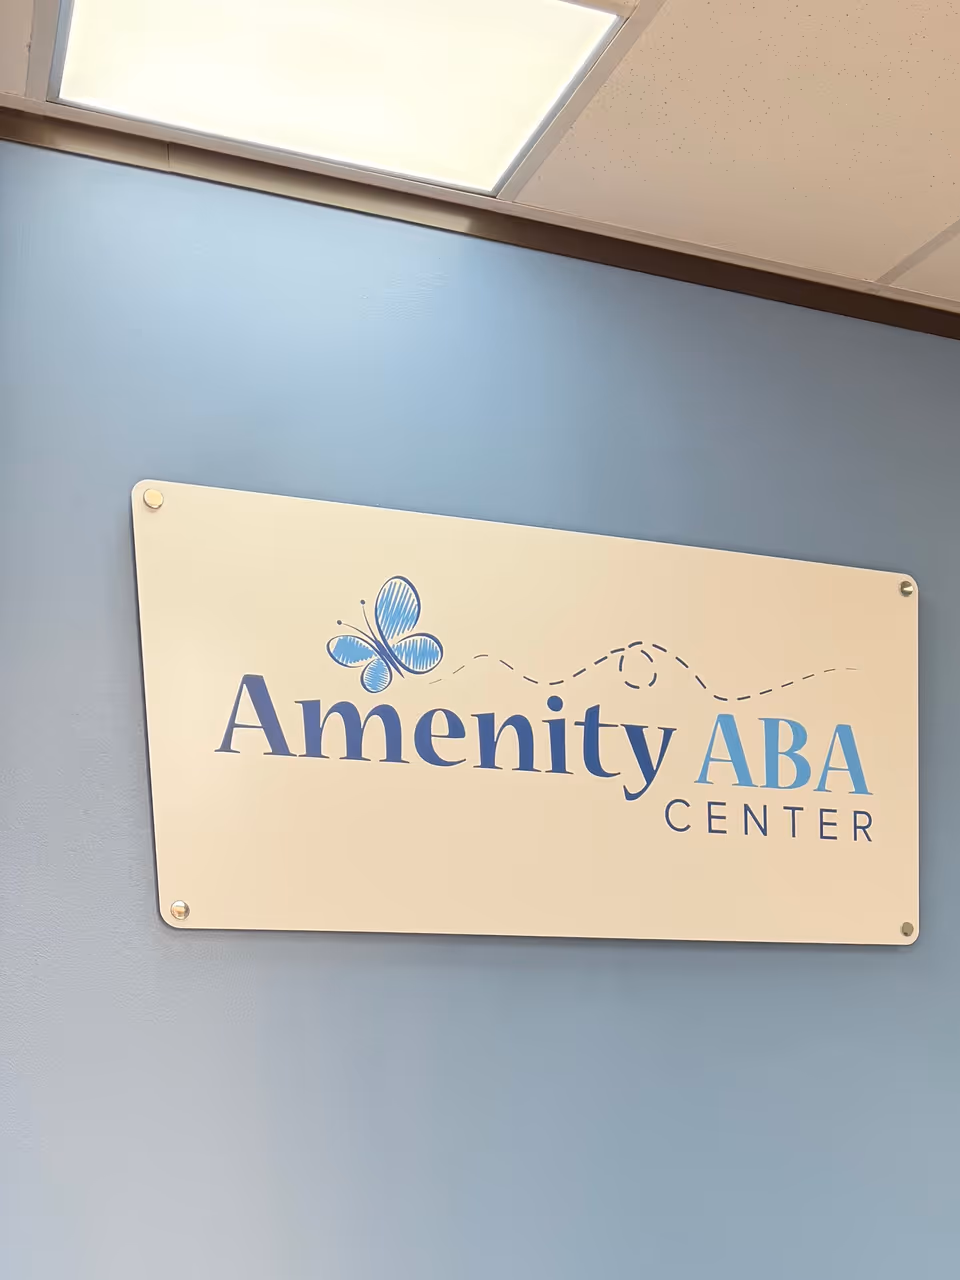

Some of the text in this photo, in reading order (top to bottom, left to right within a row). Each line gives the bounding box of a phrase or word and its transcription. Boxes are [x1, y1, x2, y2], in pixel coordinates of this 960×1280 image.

[214, 673, 874, 800] Amenity ABA
[664, 798, 874, 842] CENTER
